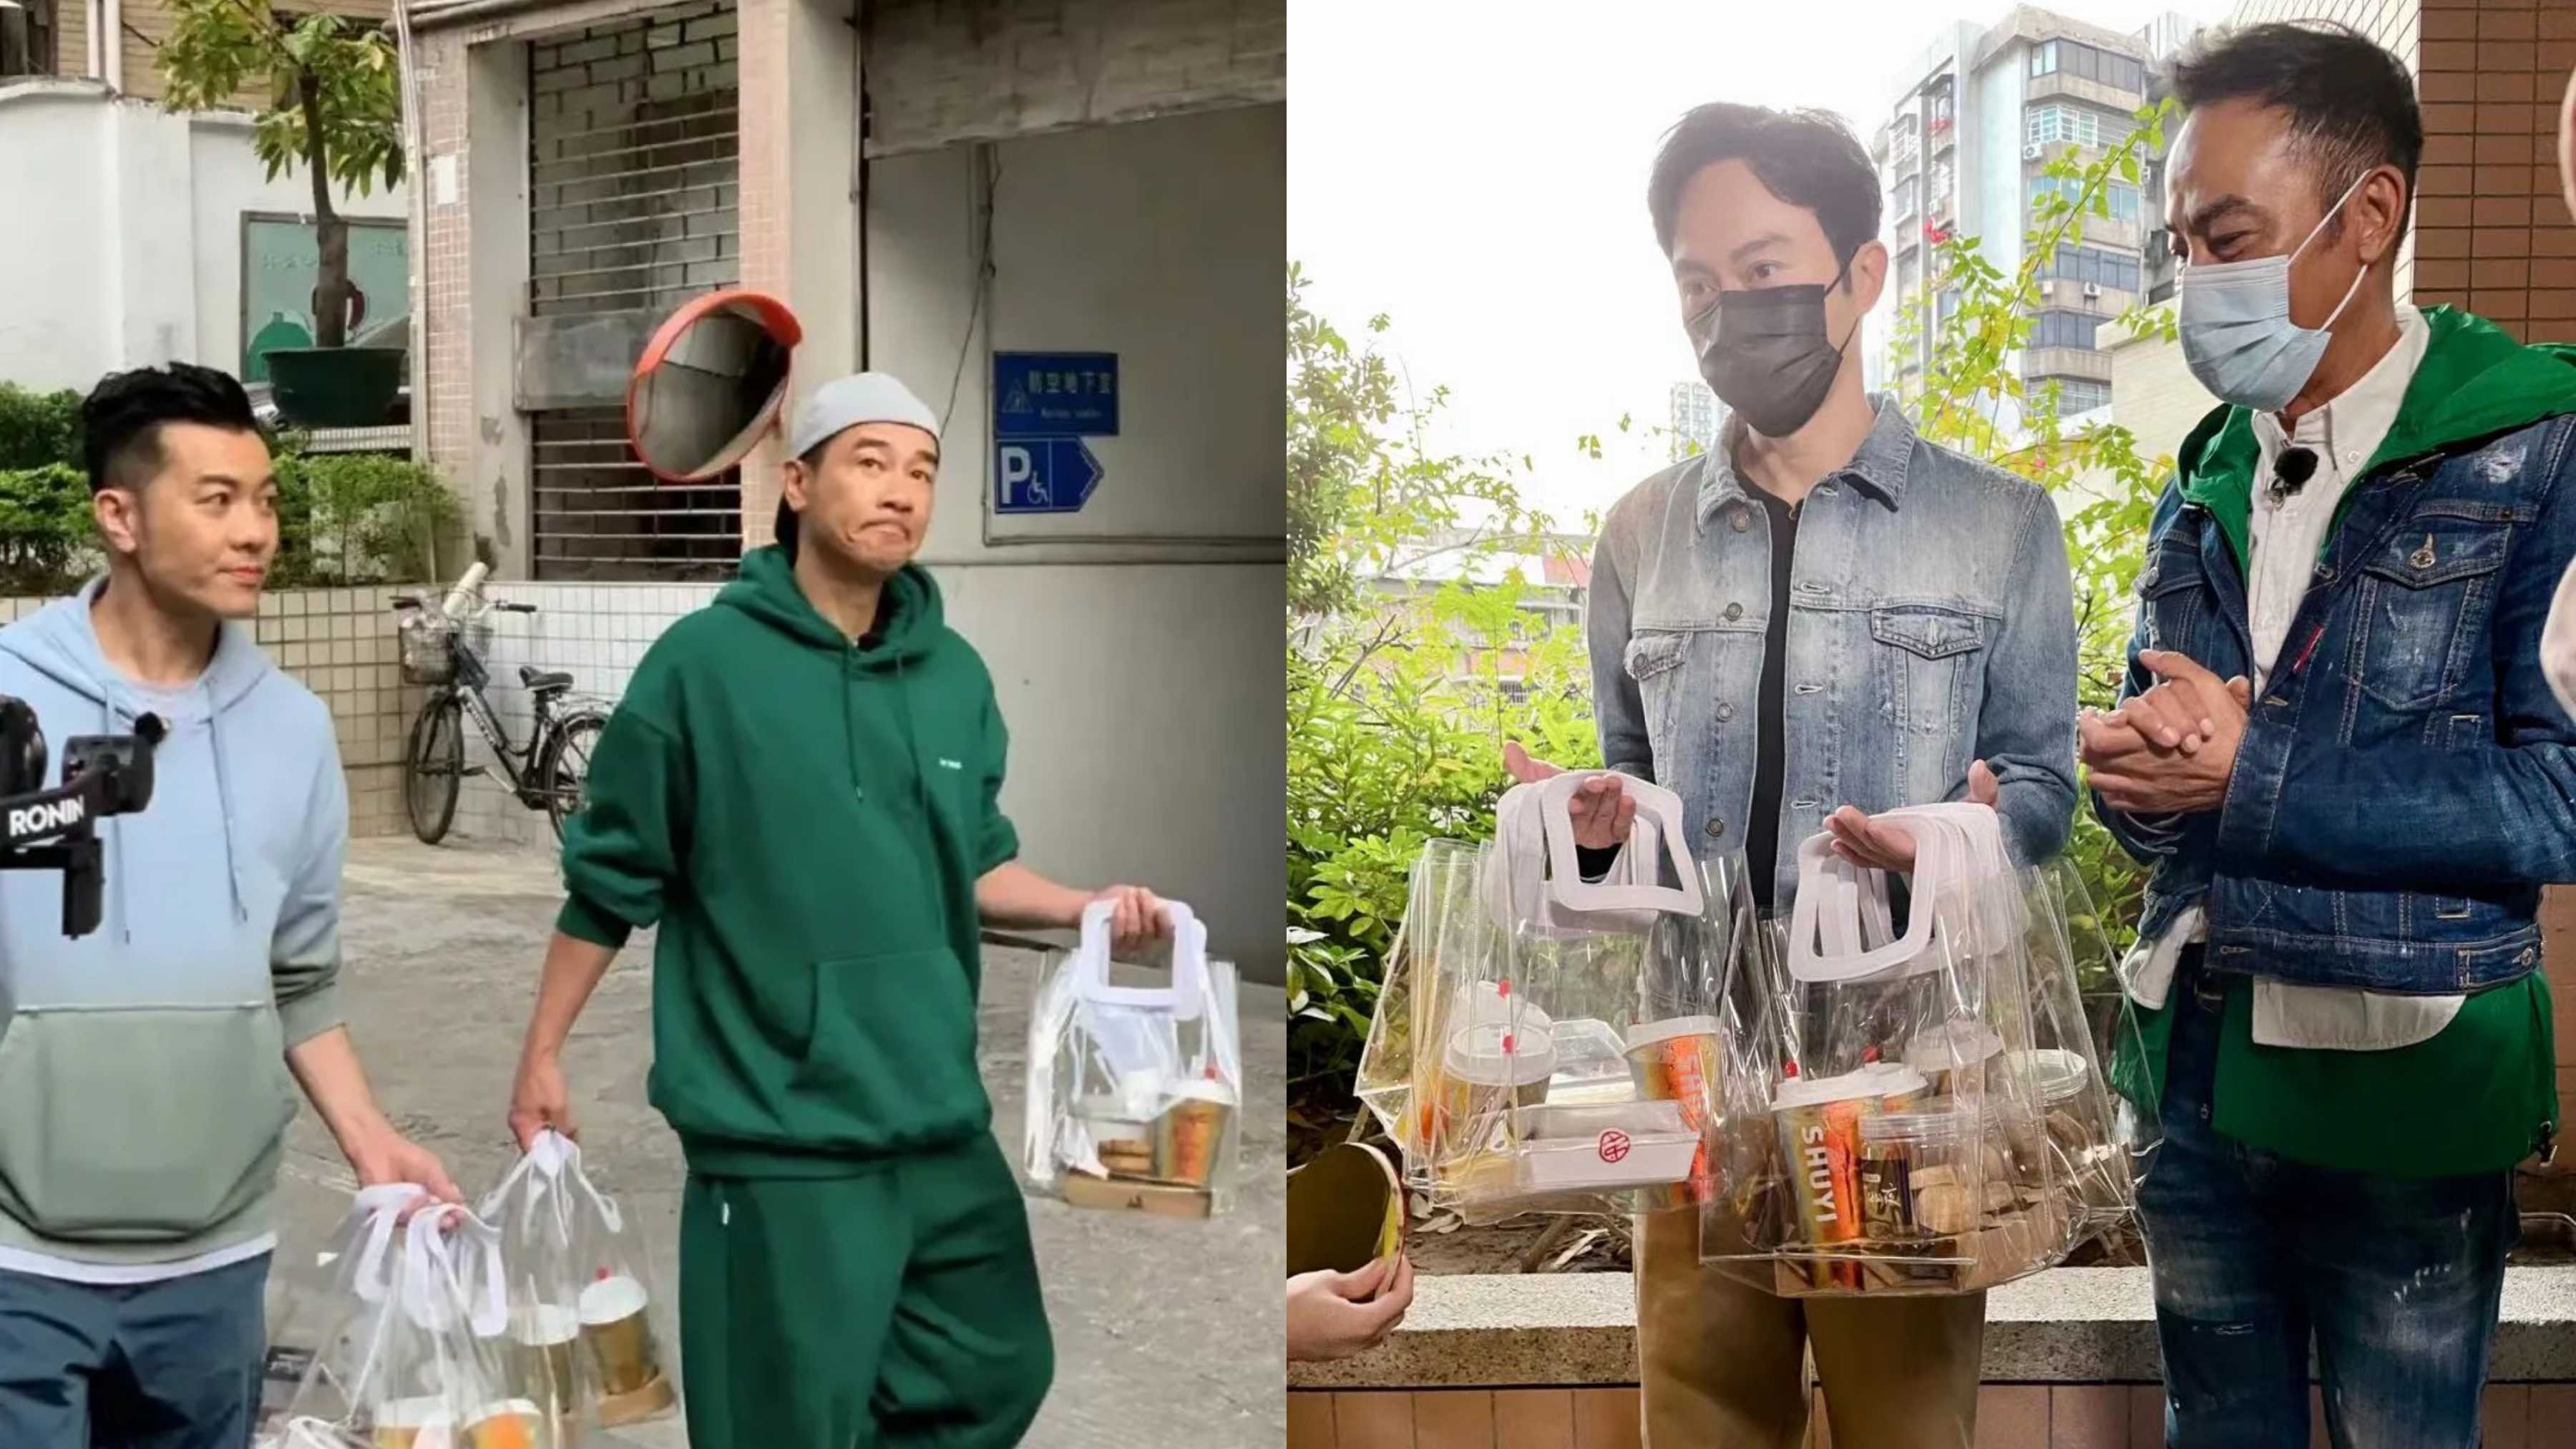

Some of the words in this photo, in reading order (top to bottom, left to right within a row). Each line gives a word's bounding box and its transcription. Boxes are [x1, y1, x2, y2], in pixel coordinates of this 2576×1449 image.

[1001, 446, 1031, 504] P
[9, 794, 85, 837] RONIN
[1802, 1125, 1838, 1222] SHUYI
